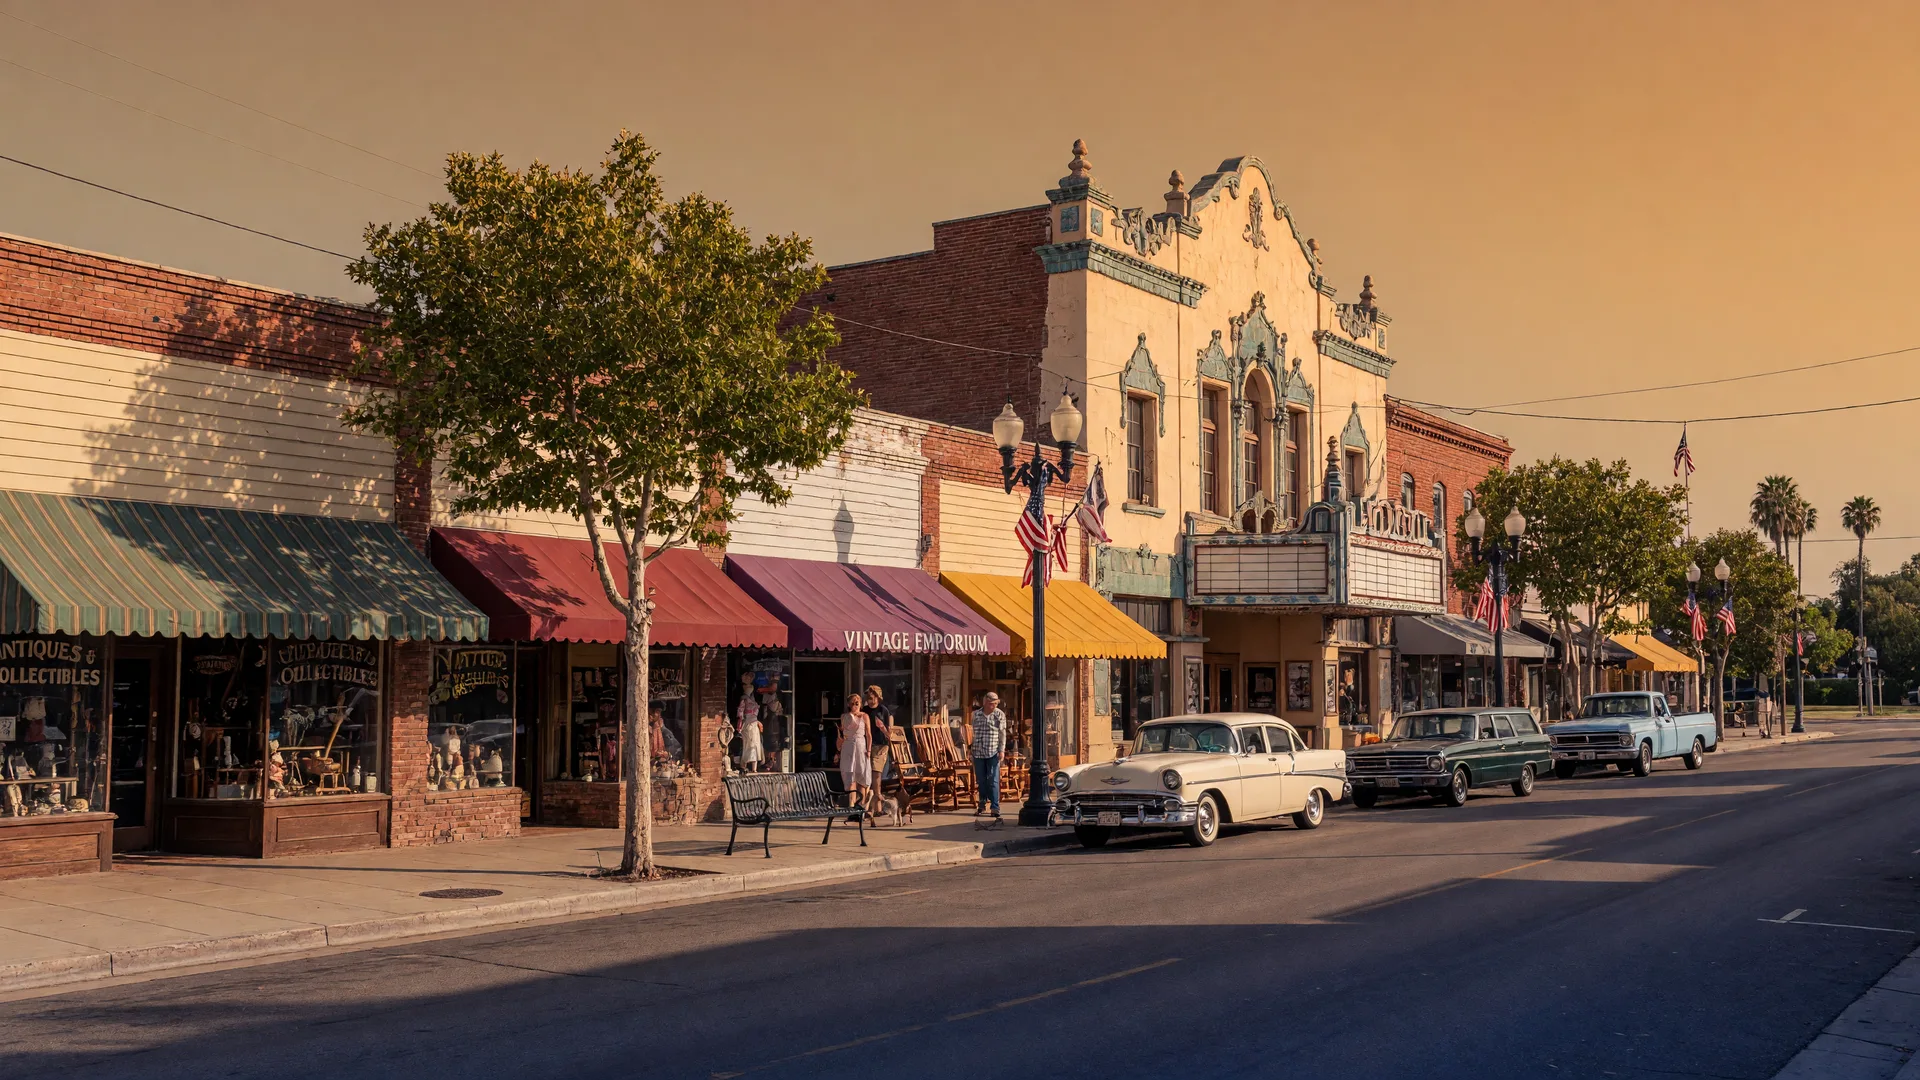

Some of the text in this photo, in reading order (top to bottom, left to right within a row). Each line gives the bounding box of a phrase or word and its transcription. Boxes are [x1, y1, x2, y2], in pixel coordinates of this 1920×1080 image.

[0, 640, 83, 662] NTIQUES
[844, 630, 989, 652] VINTAGE EMPORIUM
